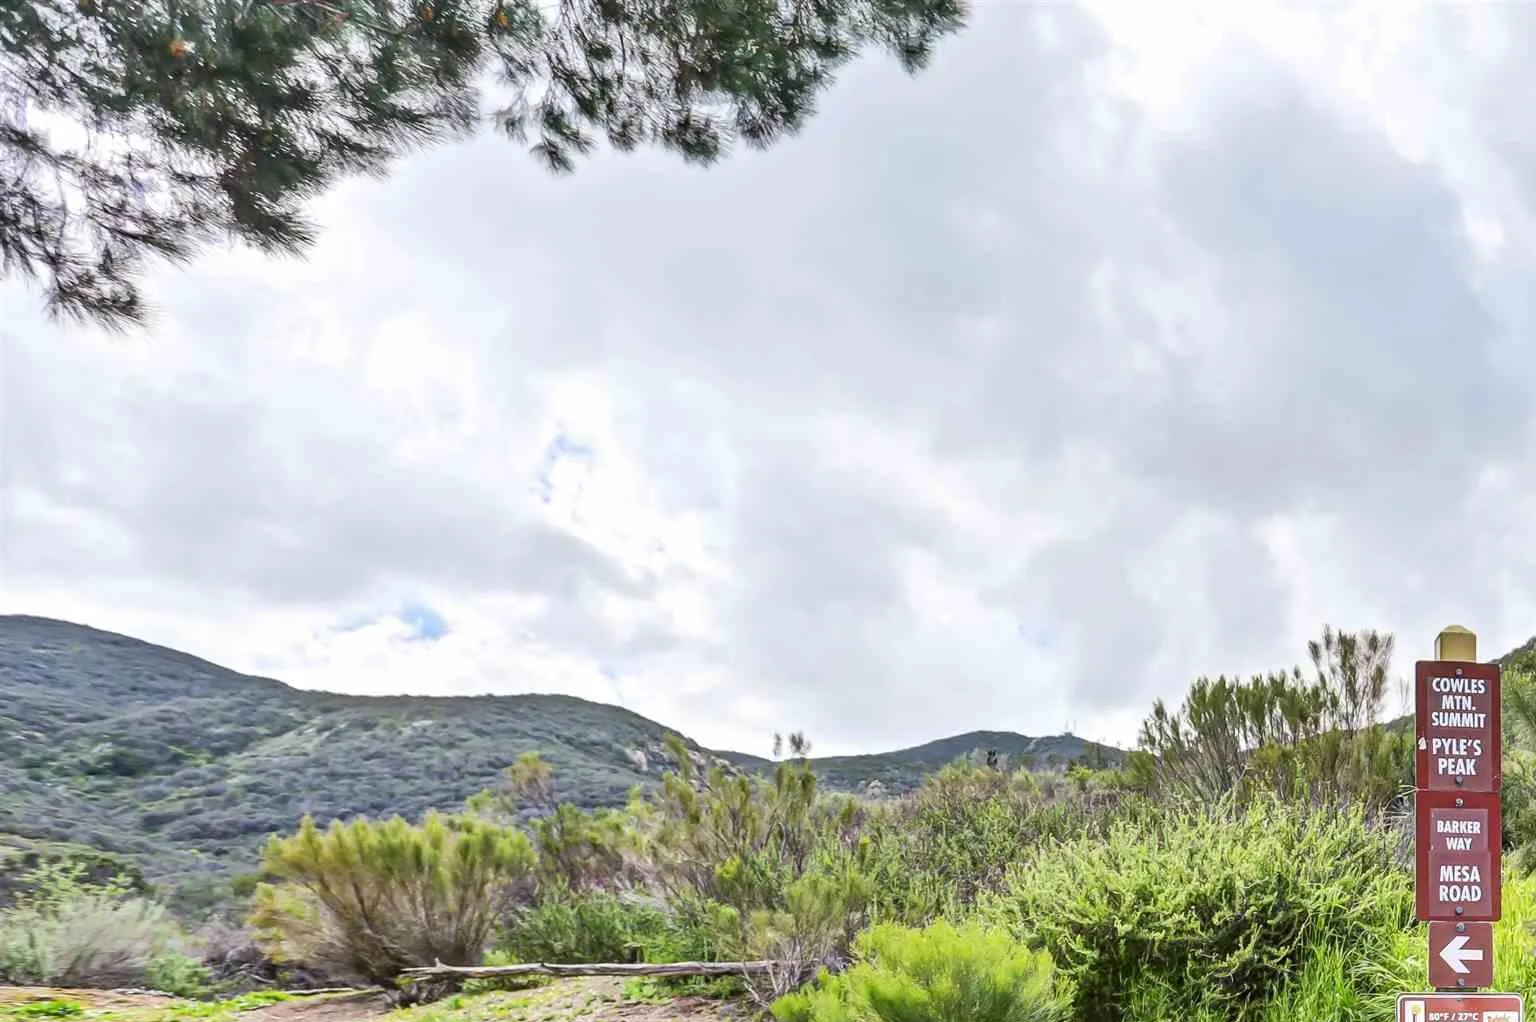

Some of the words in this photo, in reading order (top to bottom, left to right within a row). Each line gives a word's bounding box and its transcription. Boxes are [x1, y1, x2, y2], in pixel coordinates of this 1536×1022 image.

[1432, 678, 1486, 694] COWLES
[1442, 694, 1476, 711] MTN.
[1432, 712, 1486, 728] SUMMIT
[1432, 738, 1482, 756] PYLE'S
[1438, 758, 1476, 776] PEAK
[1437, 820, 1480, 834] BARKER
[1446, 836, 1472, 850] WAY
[1440, 866, 1480, 882] MESA
[1440, 884, 1482, 902] ROAD
